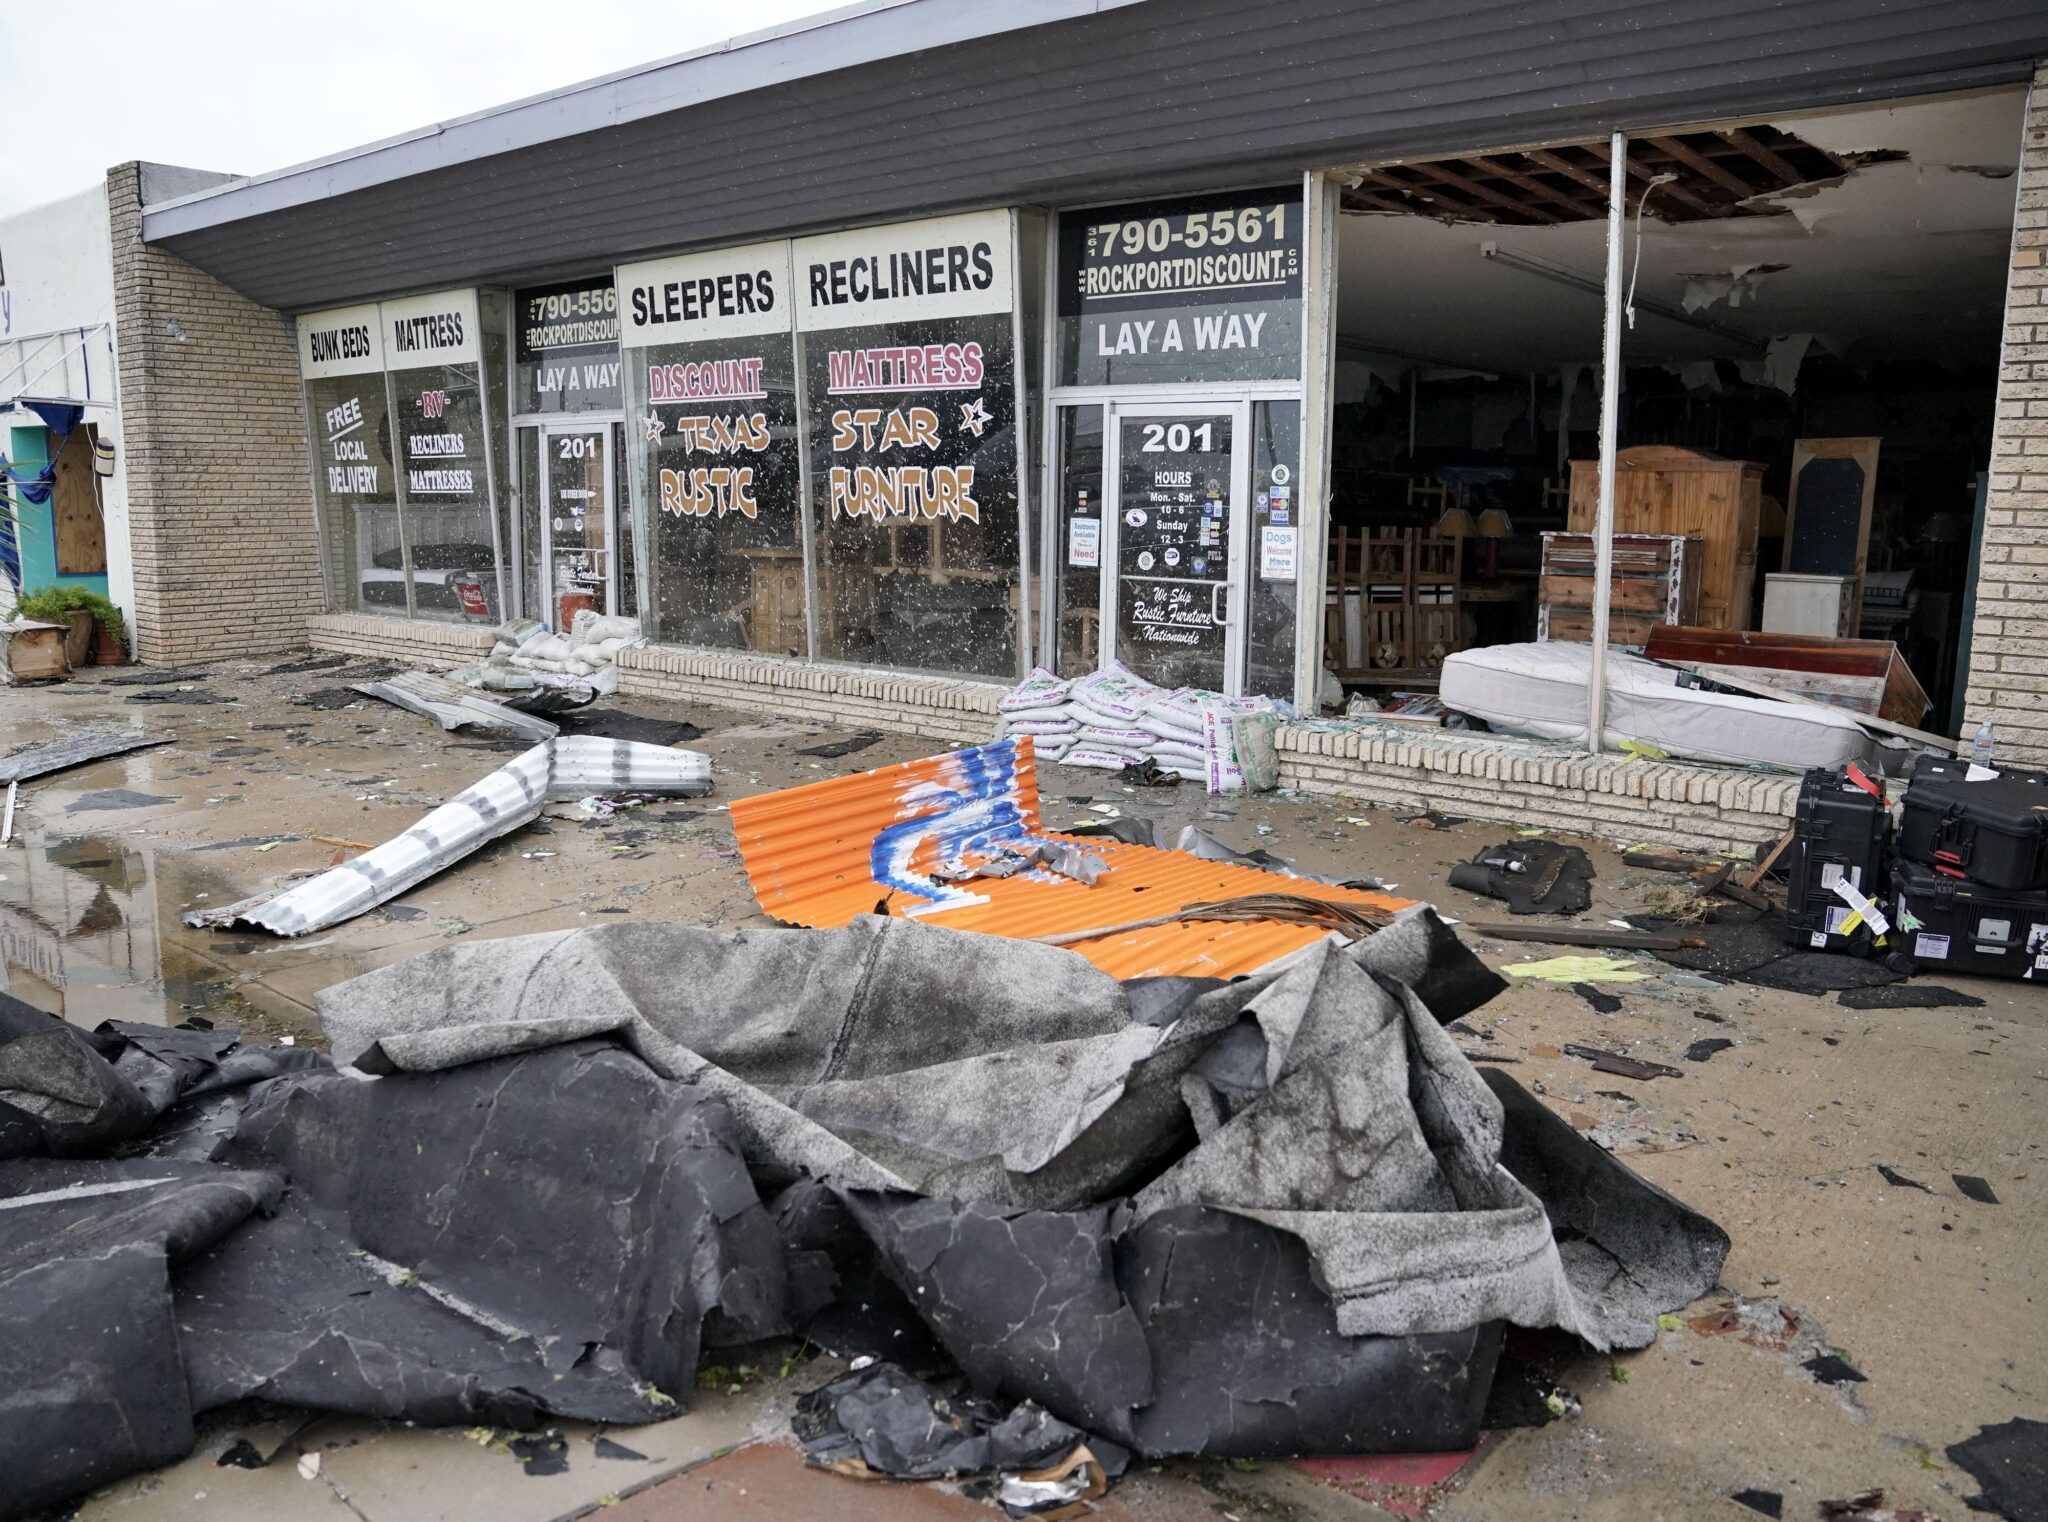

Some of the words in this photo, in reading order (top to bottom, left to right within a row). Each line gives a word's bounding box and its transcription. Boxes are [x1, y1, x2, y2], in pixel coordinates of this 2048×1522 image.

[1099, 204, 1285, 257] 790-5561
[809, 242, 993, 307] RECLINERS
[631, 269, 775, 327] SLEEPERS
[395, 311, 463, 352] MATTRESS
[1099, 320, 1155, 356] LAY
[1161, 319, 1184, 353] A
[1194, 312, 1267, 351] WAY
[310, 332, 340, 362] BUNK
[342, 325, 370, 358] BEDS
[828, 341, 984, 388] MATTRESS
[537, 367, 566, 393] LAY
[568, 366, 580, 391] A
[584, 362, 620, 389] WAY
[649, 357, 764, 399] DISCOUNT
[326, 397, 362, 433] FREE
[678, 412, 770, 456] TEXAS
[832, 407, 942, 453] STAR
[1142, 423, 1212, 452] 201
[334, 440, 368, 461] LOCAL
[410, 433, 465, 455] RECLINERS
[559, 436, 596, 459] 201
[328, 465, 377, 494] DELIVERY
[410, 469, 473, 490] MATTRESSES
[1154, 471, 1192, 484] HOURS
[660, 467, 758, 520] RUSTIC
[829, 465, 980, 525] FURNITURE
[1150, 492, 1171, 502] Mon.
[1178, 492, 1196, 503] Sat.
[1161, 505, 1171, 514] 10
[1179, 505, 1185, 514] 6
[1073, 531, 1096, 539] Available
[1156, 519, 1188, 533] Sunday
[1160, 534, 1171, 544] 12
[1178, 535, 1184, 544] 3
[1266, 531, 1292, 544] Dogs
[1074, 549, 1095, 559] Need
[1266, 545, 1293, 556] Welcome
[1269, 557, 1291, 566] Here
[1153, 586, 1168, 601] We
[1169, 587, 1192, 606] Ship
[1132, 601, 1165, 621] Rustic
[1143, 624, 1200, 646] Nationwide
[1207, 711, 1215, 726] ACE
